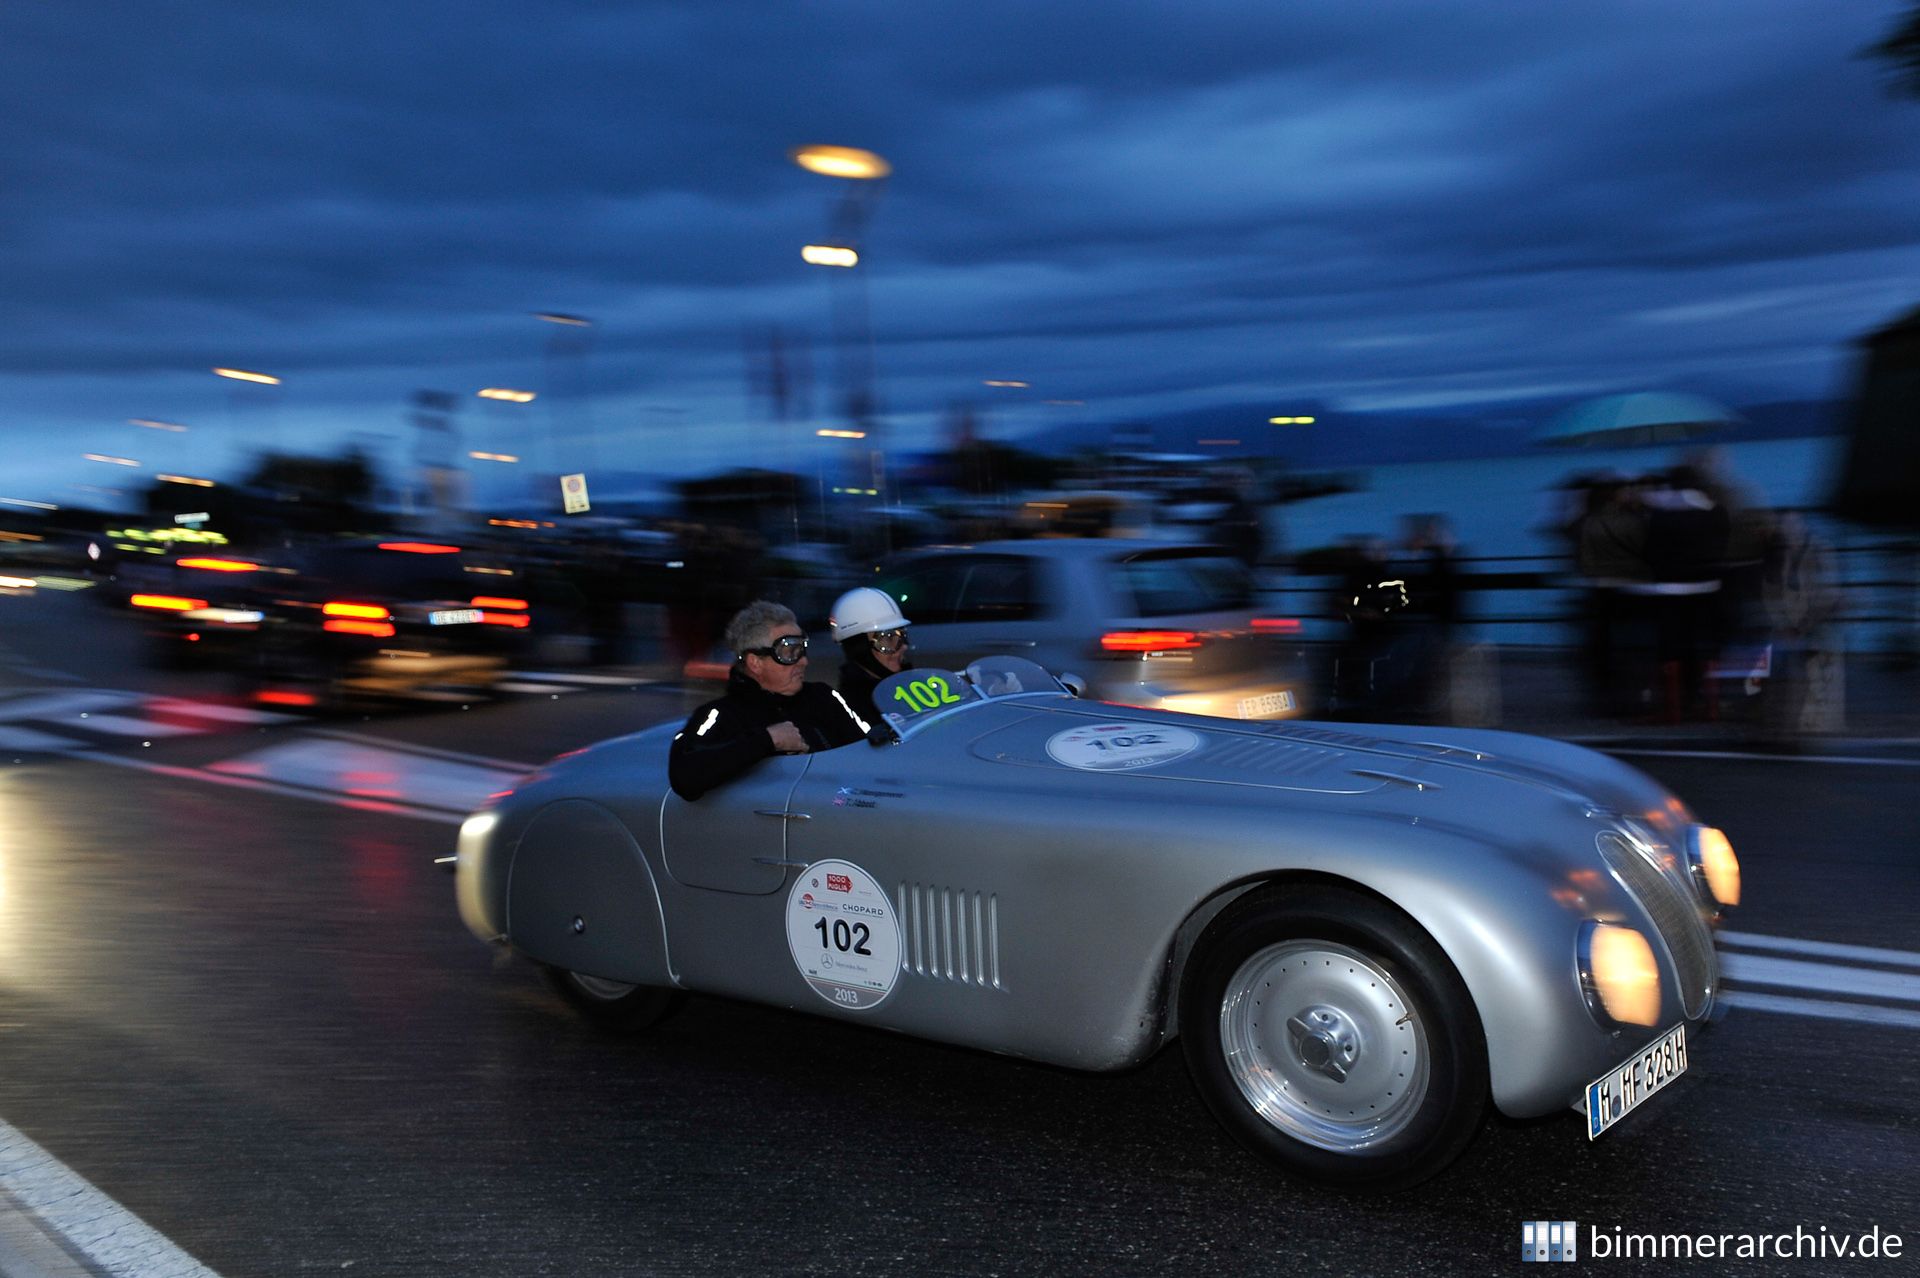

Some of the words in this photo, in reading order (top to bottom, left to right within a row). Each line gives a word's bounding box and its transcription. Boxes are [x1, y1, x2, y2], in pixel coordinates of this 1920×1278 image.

[894, 675, 961, 713] 102
[1086, 734, 1166, 751] 102
[842, 903, 884, 916] CHOPARD
[814, 917, 872, 956] 102
[834, 987, 859, 1004] 2013
